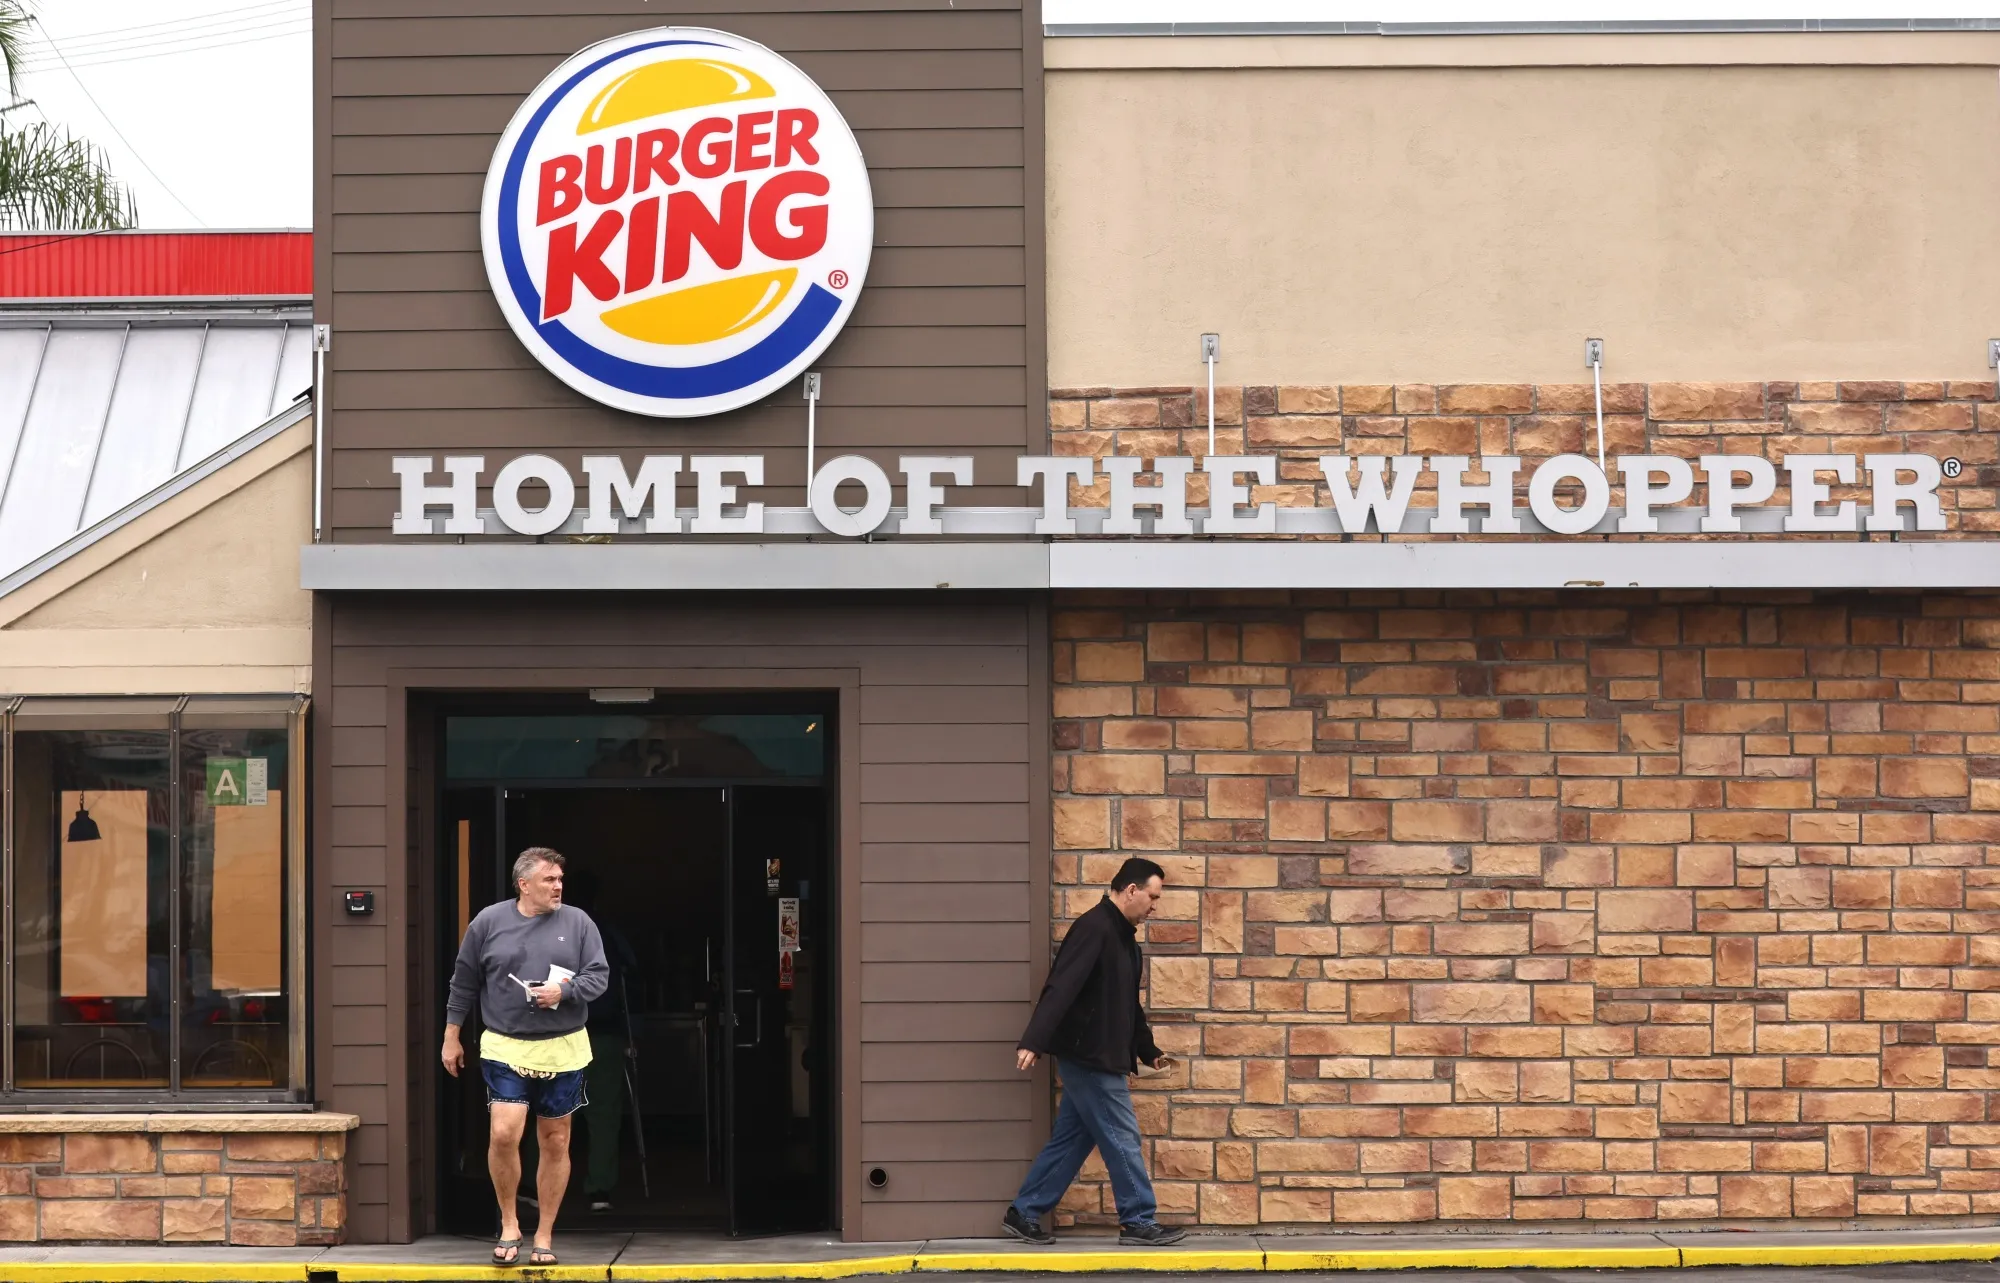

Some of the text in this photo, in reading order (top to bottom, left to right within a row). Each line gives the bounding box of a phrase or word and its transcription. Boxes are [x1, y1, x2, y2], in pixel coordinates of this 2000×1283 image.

[536, 107, 820, 227] BURGER
[542, 170, 831, 321] KING
[391, 453, 765, 536] HOME
[810, 453, 974, 537] OF
[1017, 454, 1277, 534] THE
[213, 768, 240, 796] A
